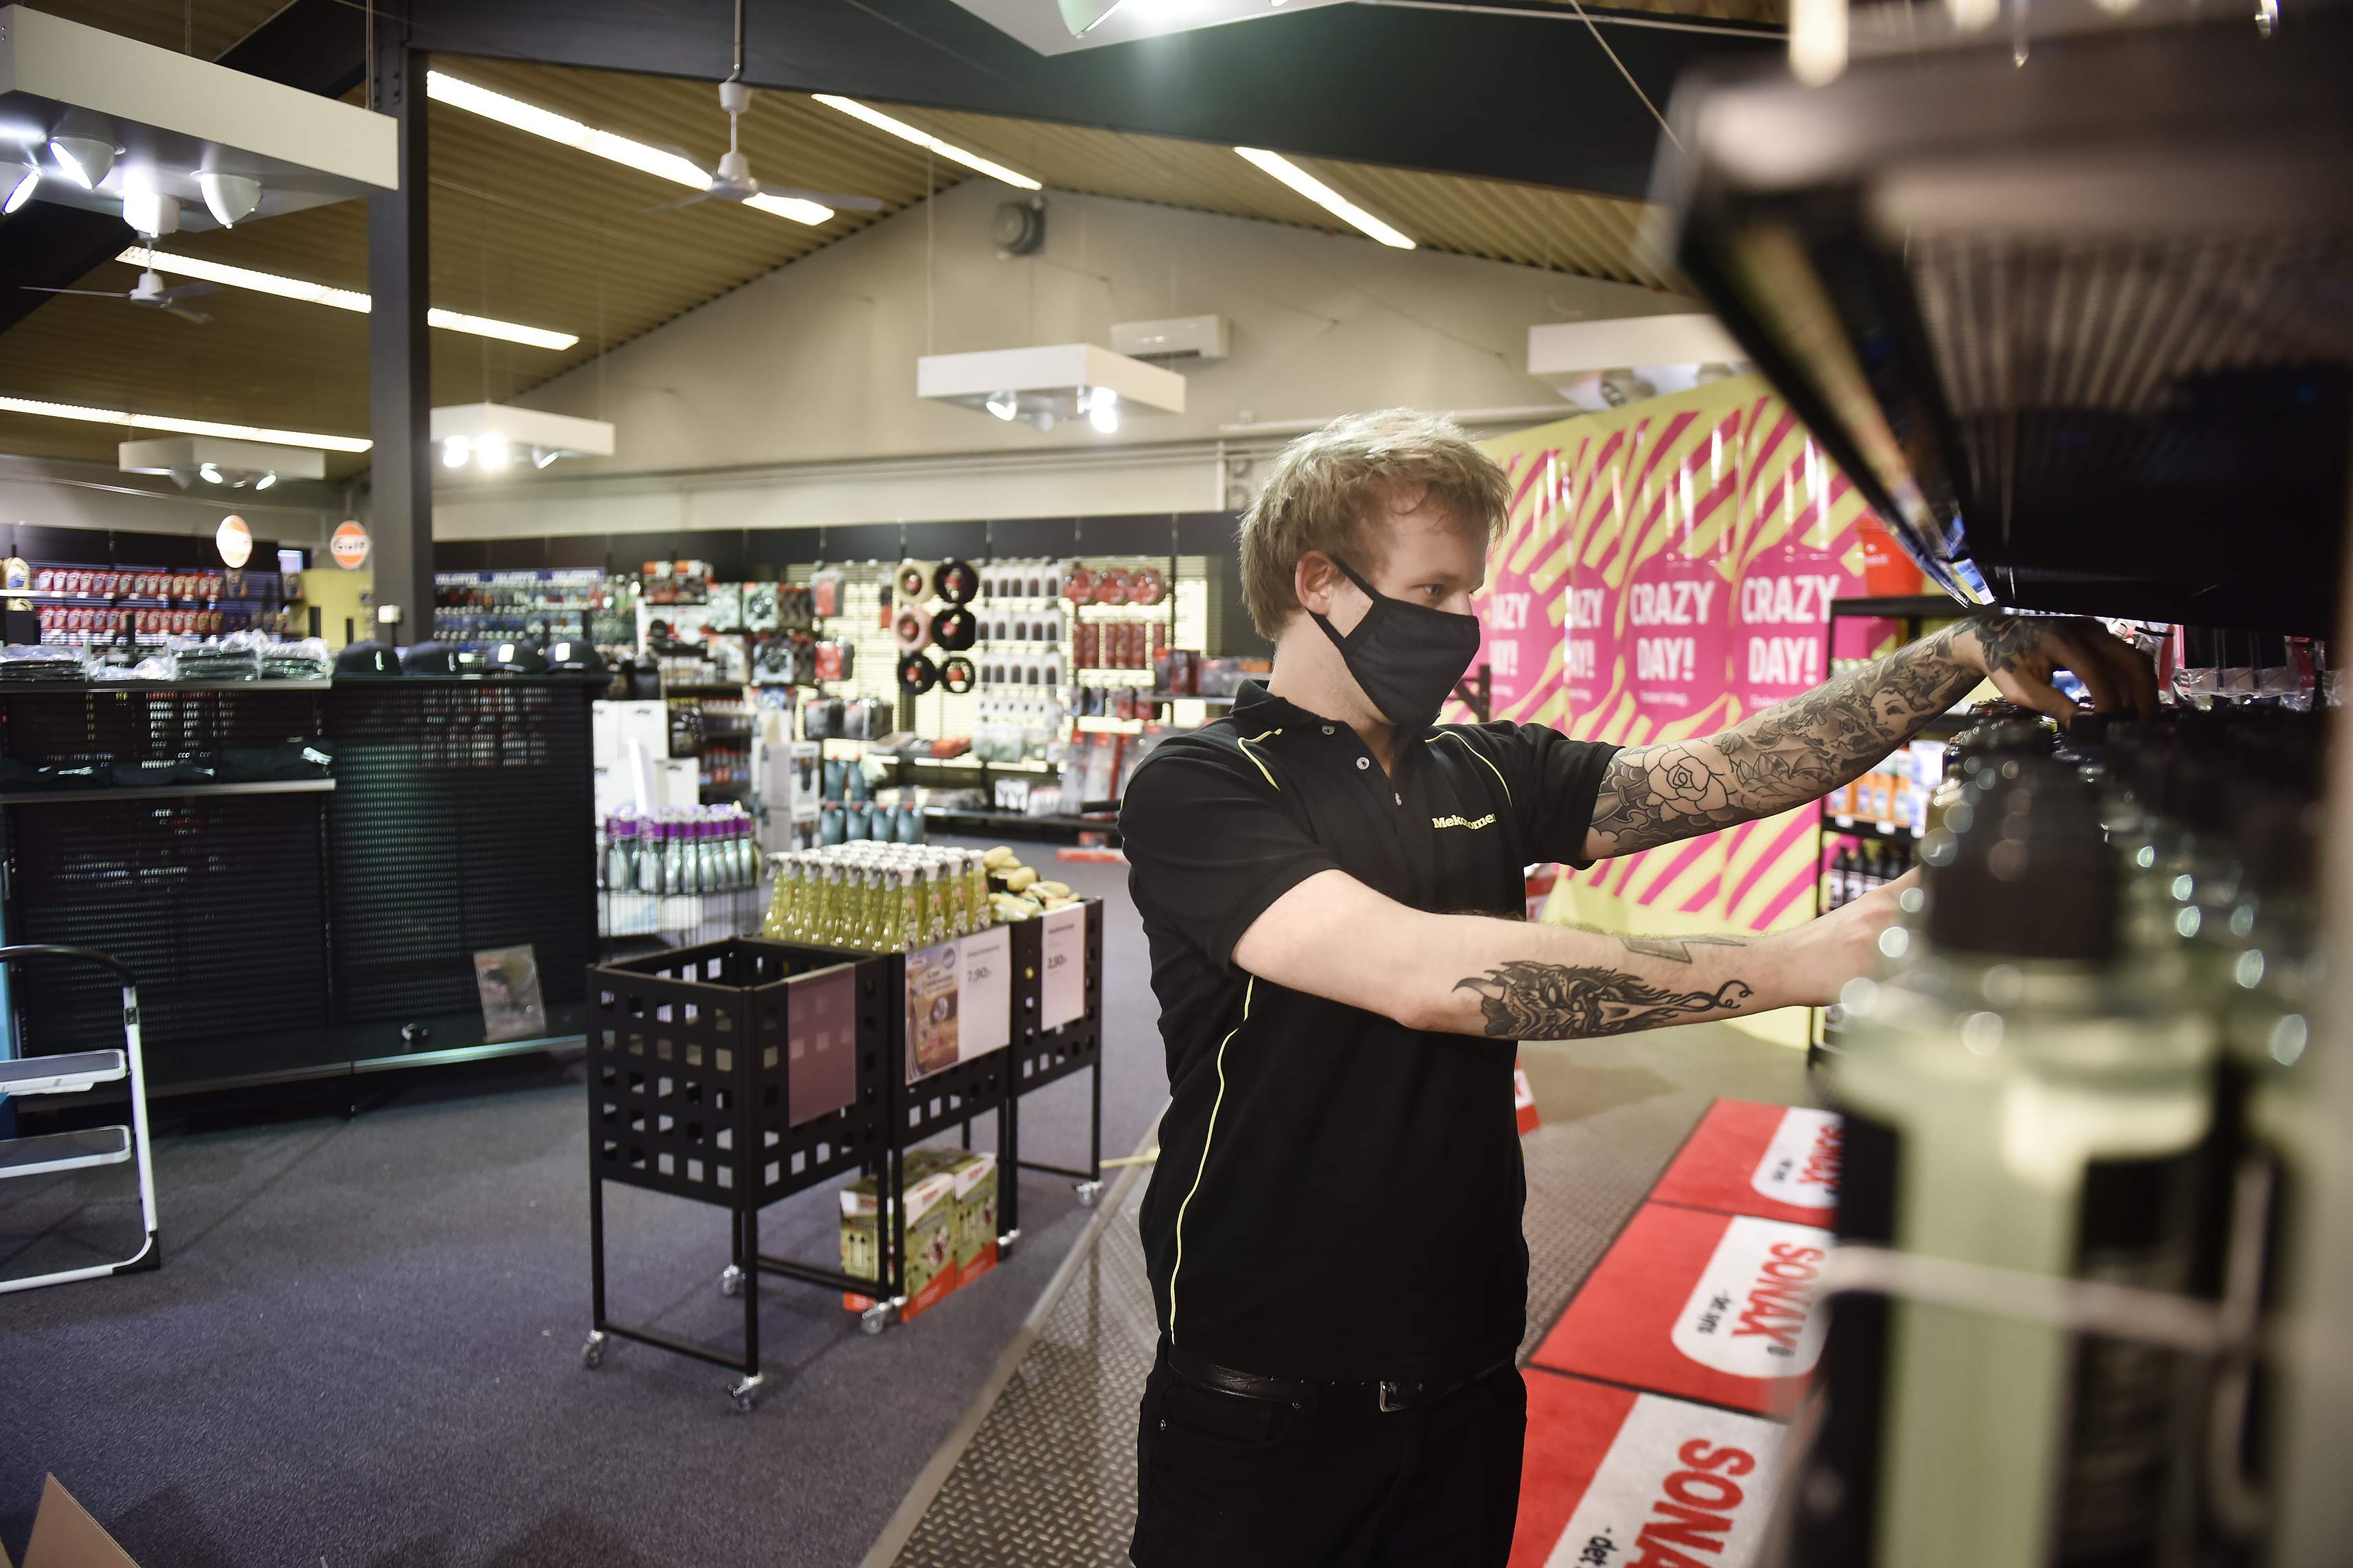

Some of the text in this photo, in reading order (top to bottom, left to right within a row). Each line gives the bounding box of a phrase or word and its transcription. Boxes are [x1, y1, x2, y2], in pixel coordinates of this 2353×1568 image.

[1630, 580, 1715, 626] CRAZY
[1742, 574, 1841, 624] CRAZY
[1637, 636, 1696, 682] DAY!
[1748, 636, 1818, 685] DAY!
[1731, 1242, 1826, 1349] SONAX
